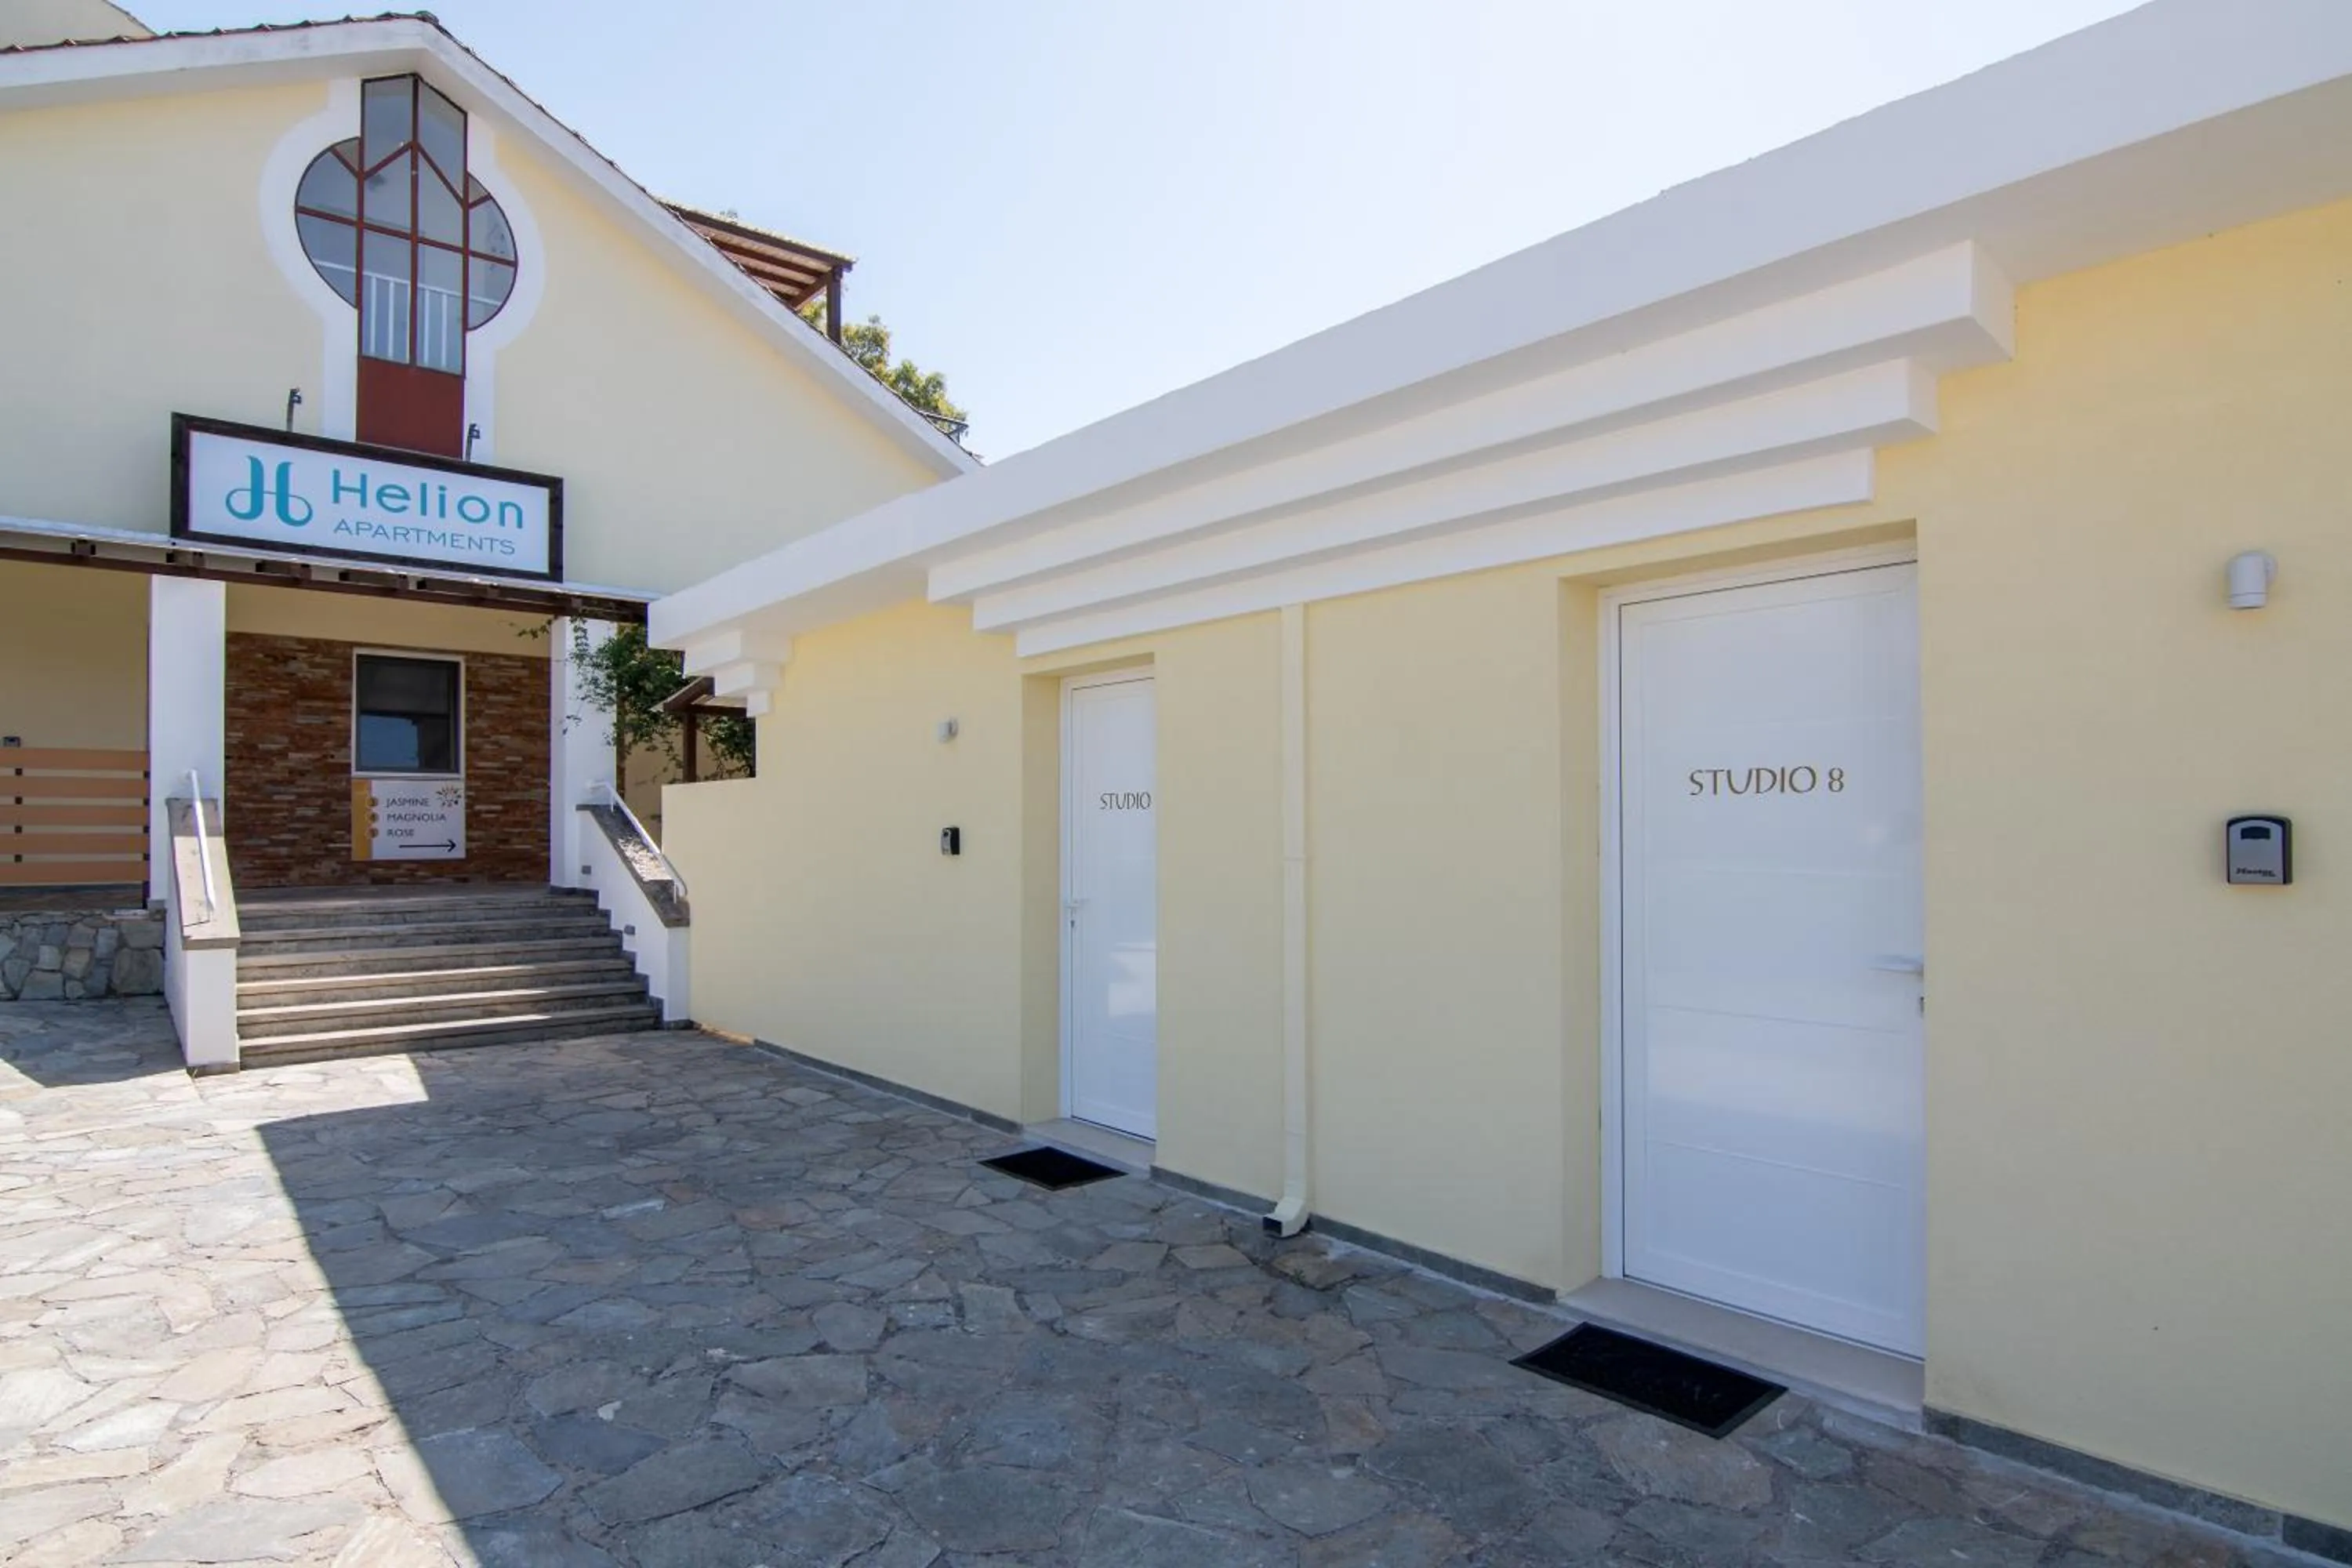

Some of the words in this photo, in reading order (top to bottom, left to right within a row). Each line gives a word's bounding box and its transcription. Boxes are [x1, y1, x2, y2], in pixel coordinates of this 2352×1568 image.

[332, 469, 524, 529] Helion
[333, 518, 516, 556] APARTMENTS
[1690, 766, 1817, 796] STUDIO
[1828, 767, 1844, 793] 8
[386, 797, 430, 808] JASMINE
[1099, 791, 1152, 810] STUDIO
[387, 813, 447, 822] MAGNOLIA
[387, 829, 415, 837] ROSE
